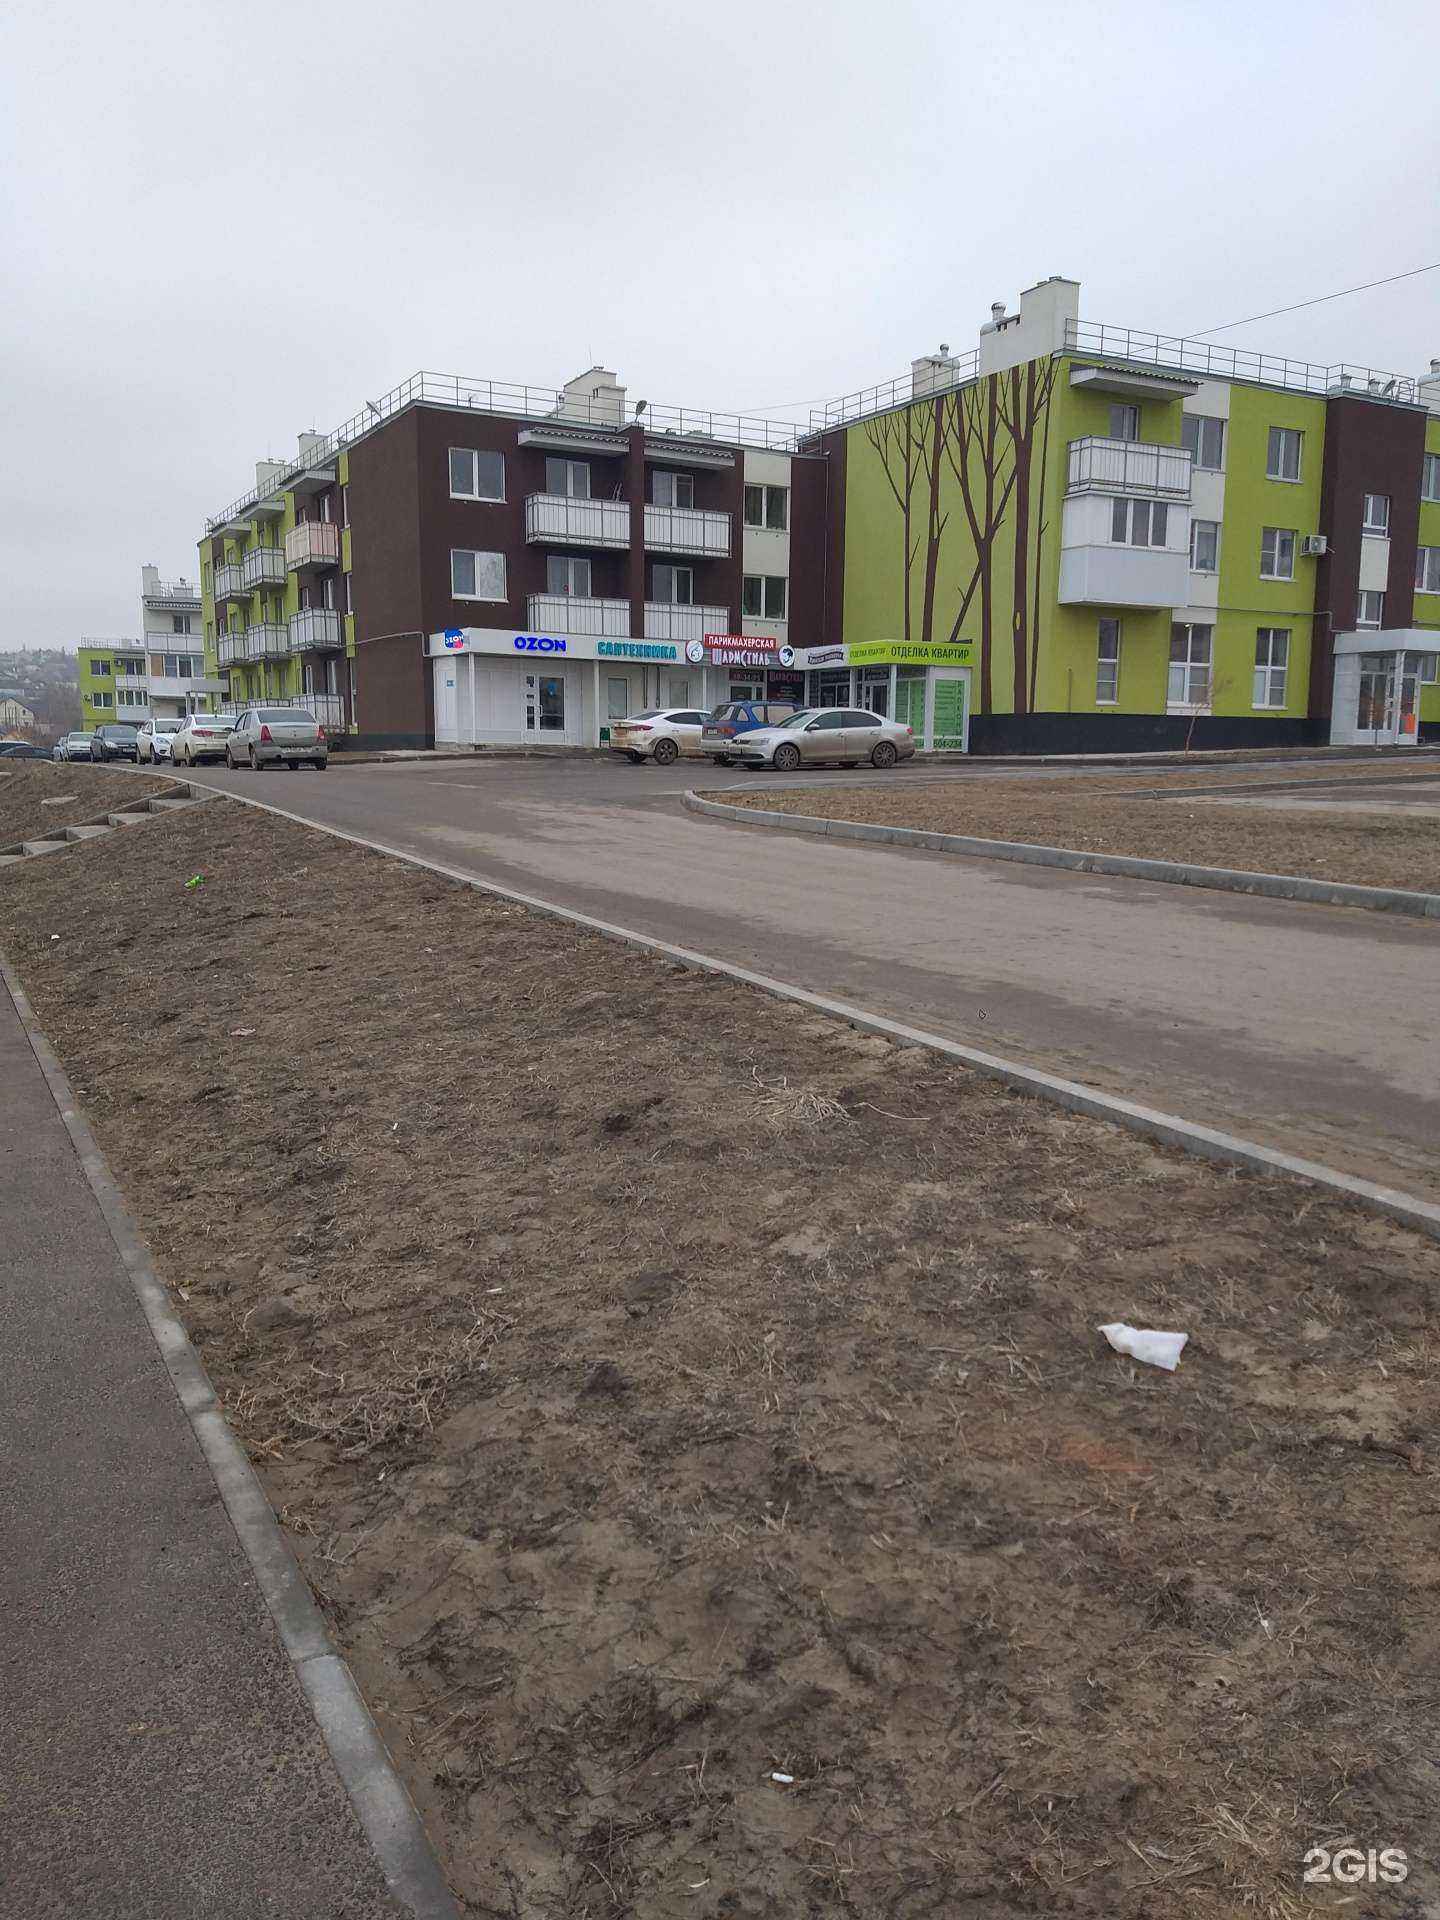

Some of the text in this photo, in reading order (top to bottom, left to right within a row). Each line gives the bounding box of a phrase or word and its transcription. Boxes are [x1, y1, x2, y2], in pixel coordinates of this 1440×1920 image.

[514, 636, 567, 652] OZON
[708, 635, 774, 649] ПАРИКМАХЕРСКАЯ
[598, 641, 677, 660] САНТЕХНИКА
[891, 646, 969, 659] ОТДЕЛКА КВАРТИР
